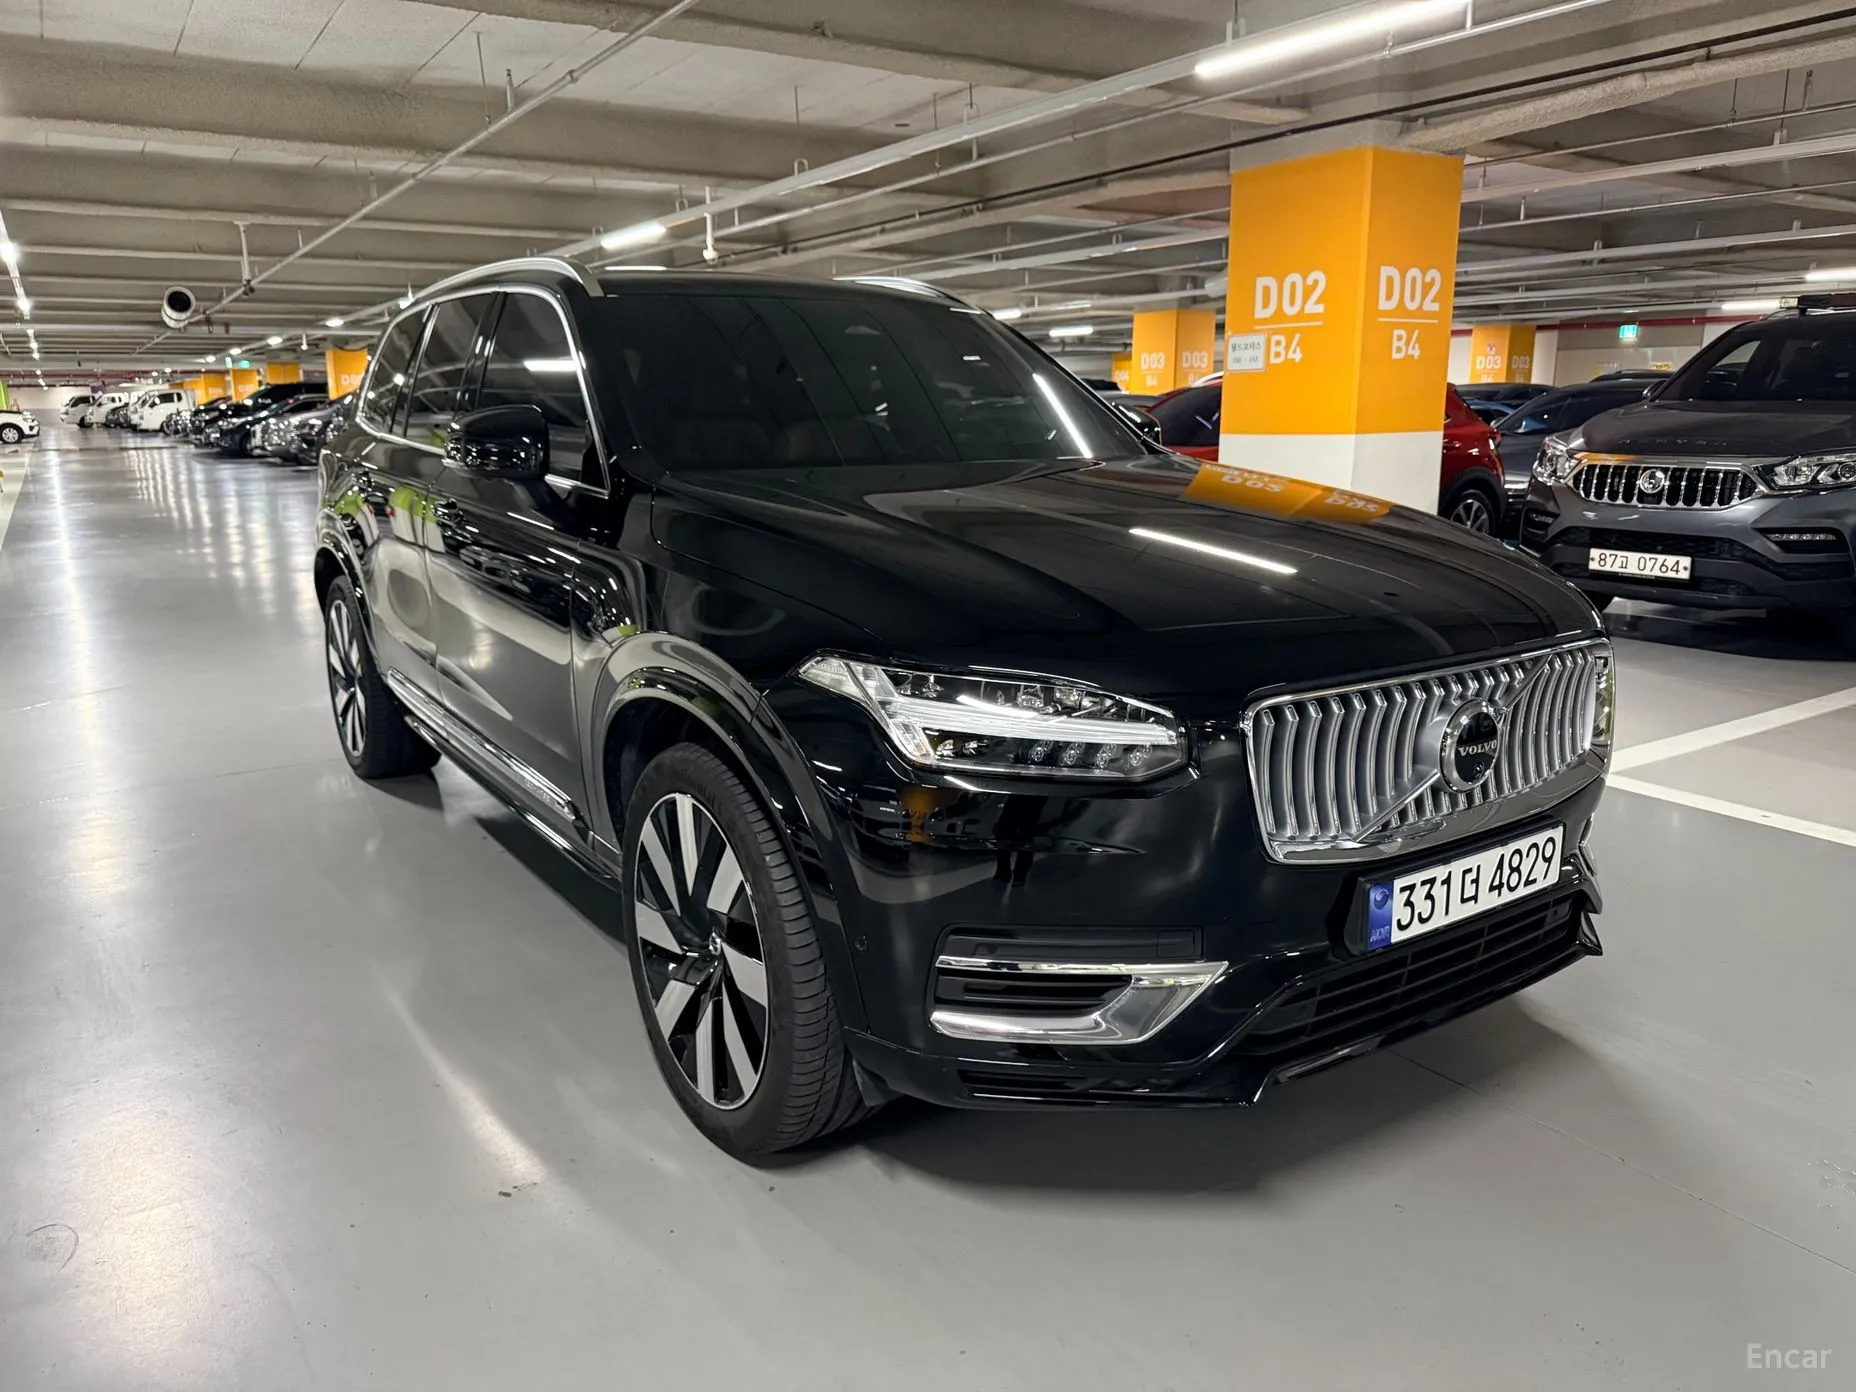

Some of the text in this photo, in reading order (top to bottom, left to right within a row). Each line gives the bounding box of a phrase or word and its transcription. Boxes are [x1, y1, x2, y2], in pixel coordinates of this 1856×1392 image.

[1254, 270, 1326, 319] D02
[1377, 265, 1441, 312] D02
[1269, 333, 1303, 364] B4
[1391, 329, 1421, 360] B4
[1141, 352, 1165, 370] D03
[1182, 351, 1208, 368] D03
[1475, 355, 1501, 369] D03
[1597, 552, 1681, 575] 87고 0764
[1457, 740, 1497, 757] VOLVO
[1396, 836, 1557, 931] 331더 4829
